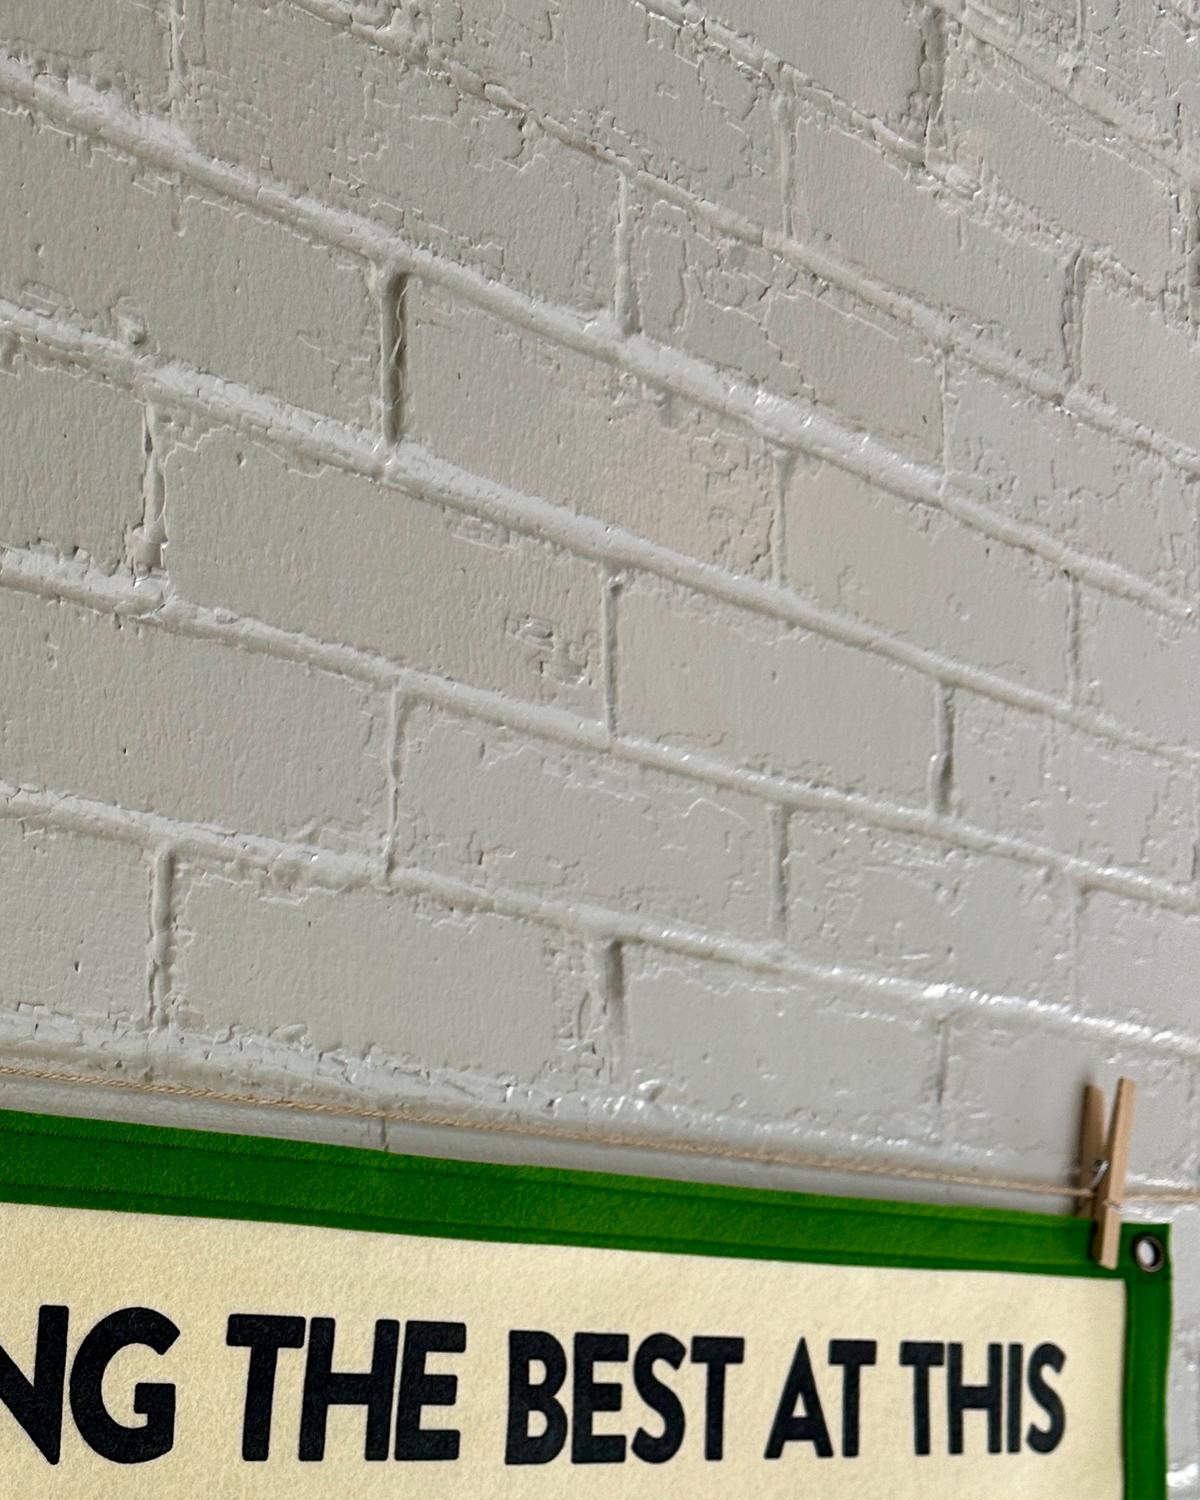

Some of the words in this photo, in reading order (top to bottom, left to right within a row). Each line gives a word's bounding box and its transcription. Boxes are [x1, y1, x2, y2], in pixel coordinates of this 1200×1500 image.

[225, 1313, 467, 1463] THE
[504, 1329, 745, 1466] BEST
[763, 1337, 877, 1460] AT
[899, 1341, 1067, 1456] THIS
